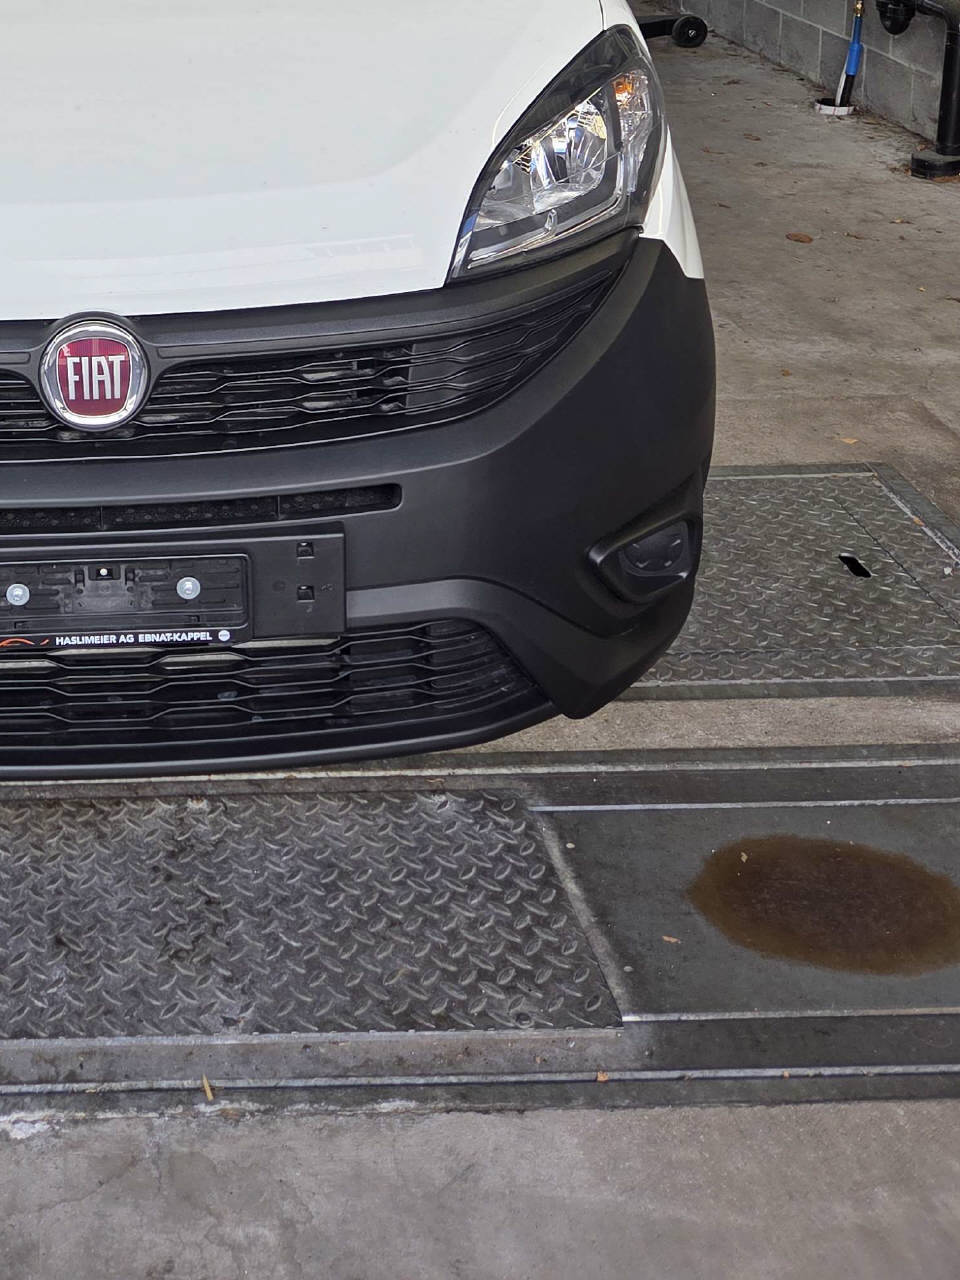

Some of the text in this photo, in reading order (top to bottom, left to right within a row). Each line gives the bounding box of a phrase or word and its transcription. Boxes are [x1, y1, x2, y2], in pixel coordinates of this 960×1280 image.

[66, 354, 125, 400] FIAT
[55, 634, 117, 646] HASLIMEIER
[118, 634, 135, 644] AG
[138, 631, 213, 643] EBNAT-KAPPEL
